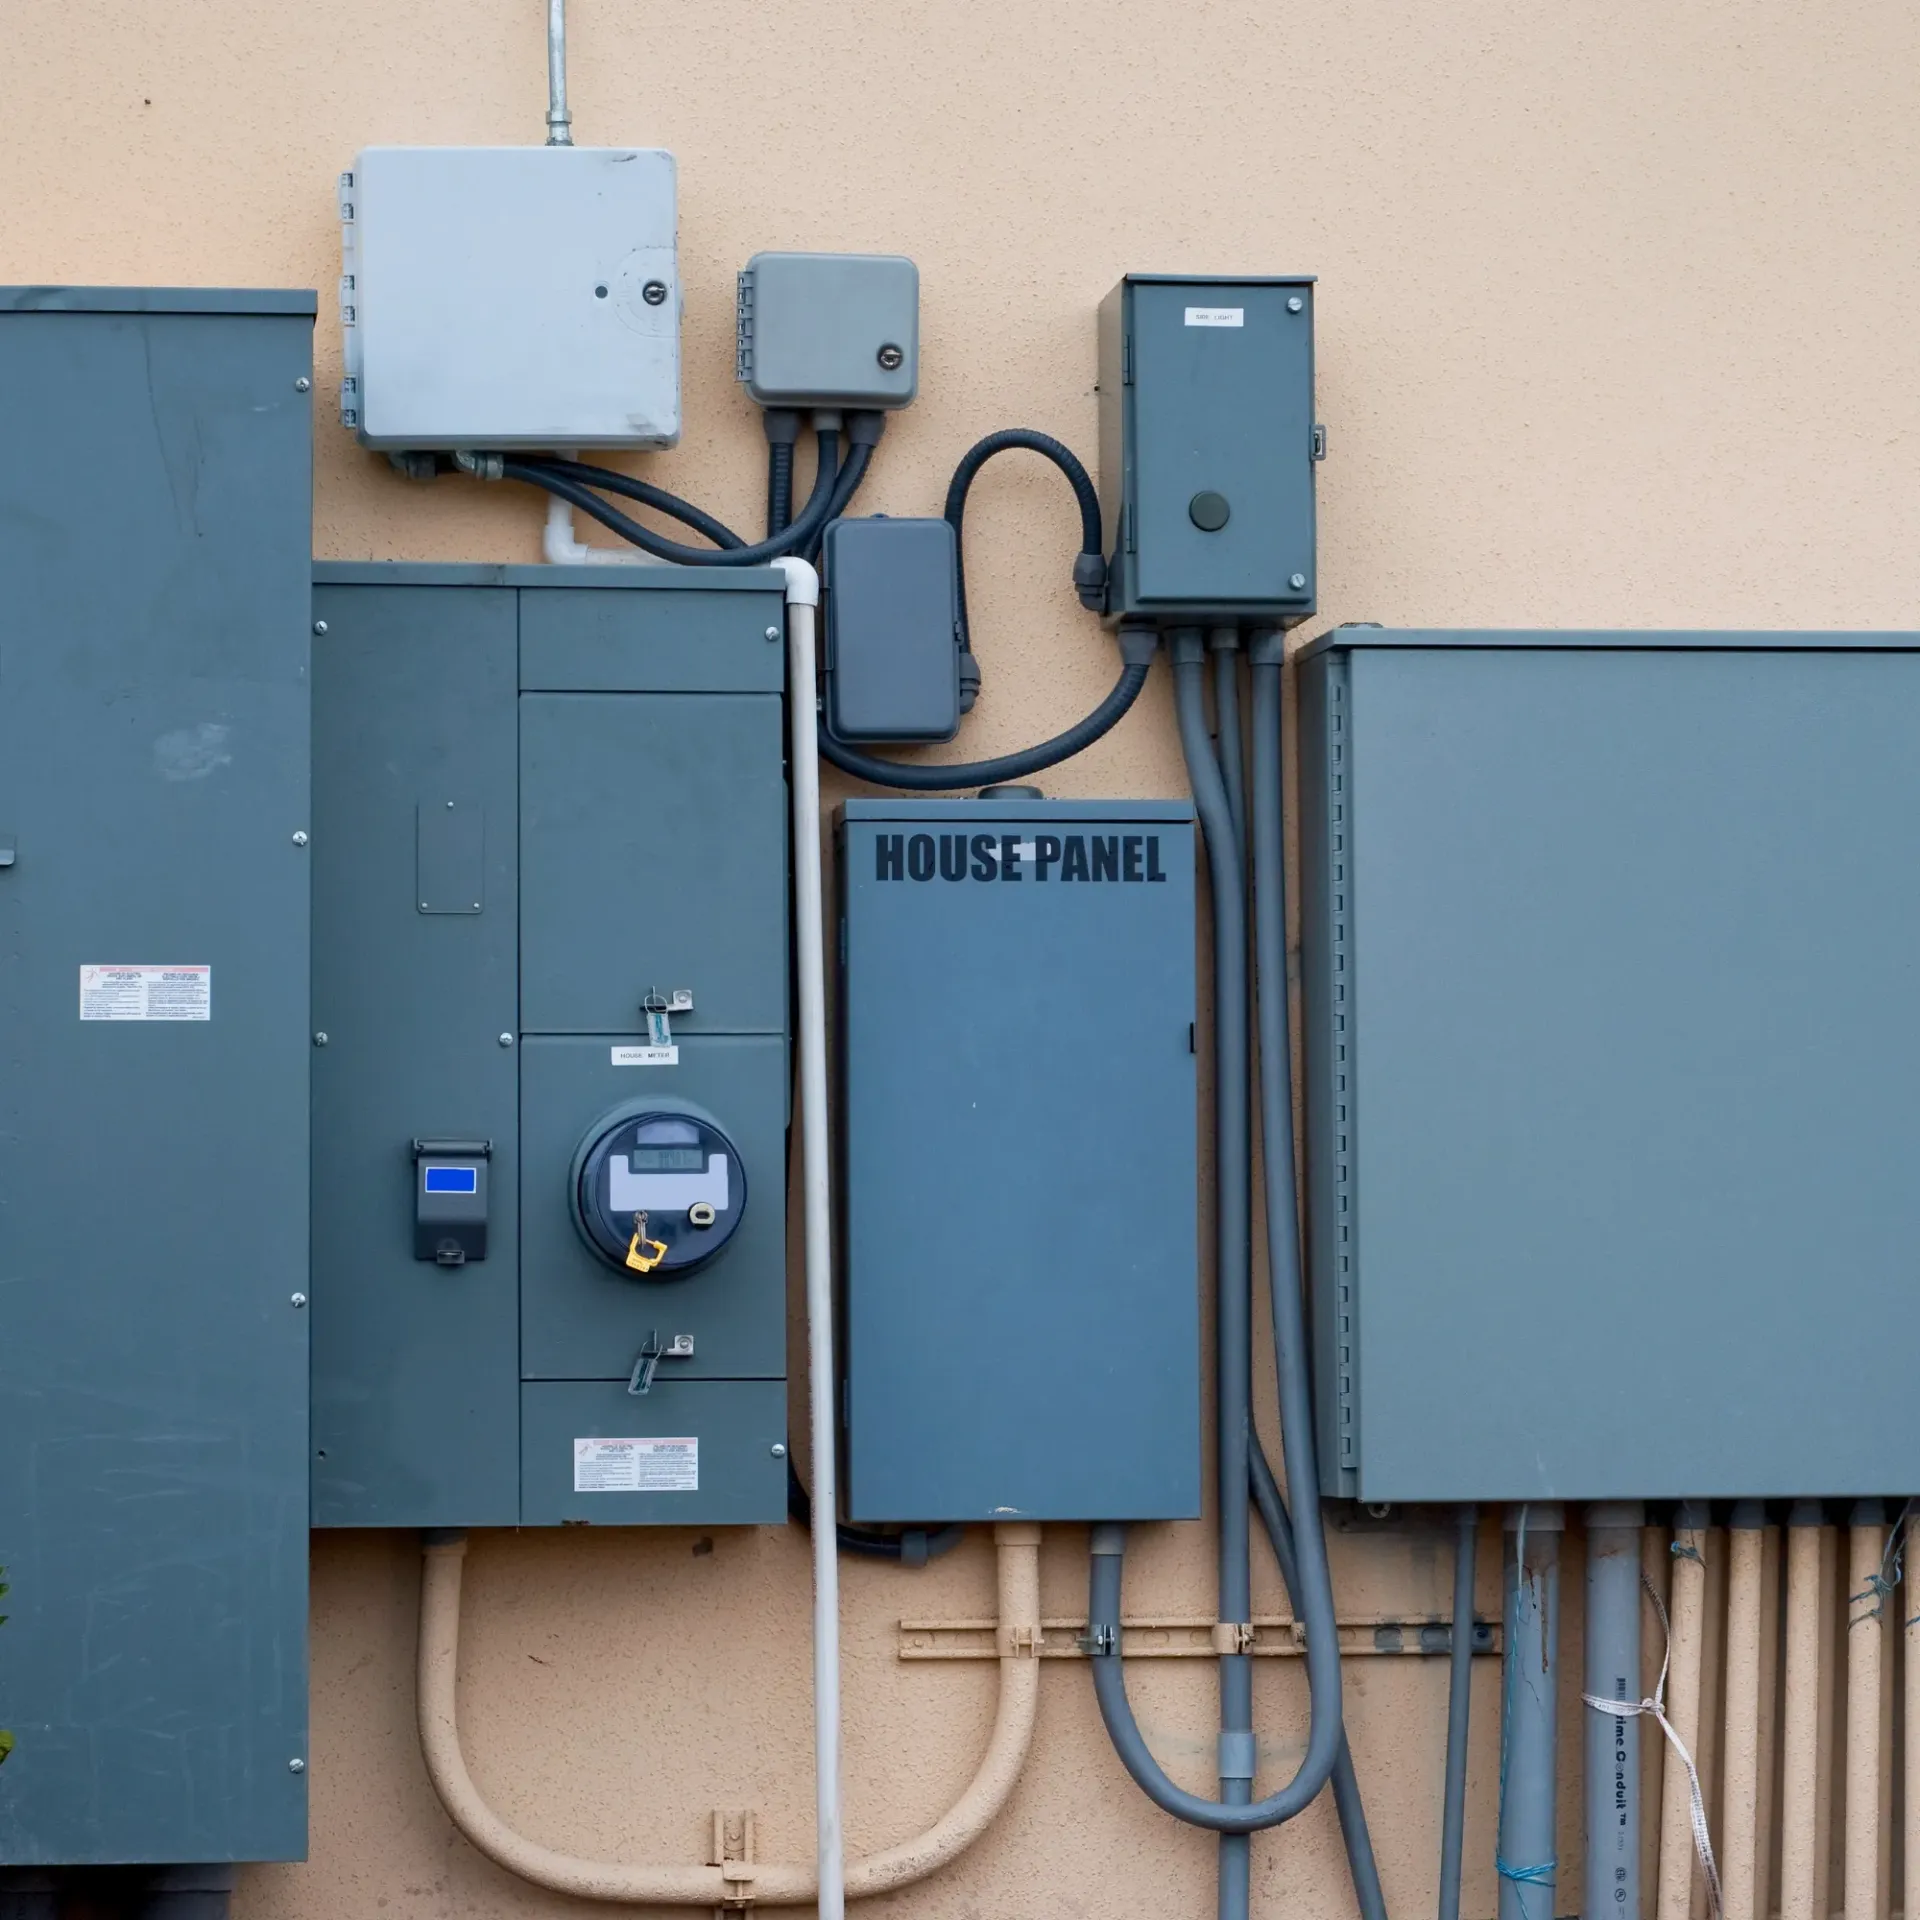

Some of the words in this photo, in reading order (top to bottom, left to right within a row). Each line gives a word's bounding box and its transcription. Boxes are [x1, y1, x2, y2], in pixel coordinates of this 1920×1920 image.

[876, 833, 1022, 883] HOUSE
[1035, 835, 1167, 883] PANEL
[1615, 1716, 1627, 1746] rime
